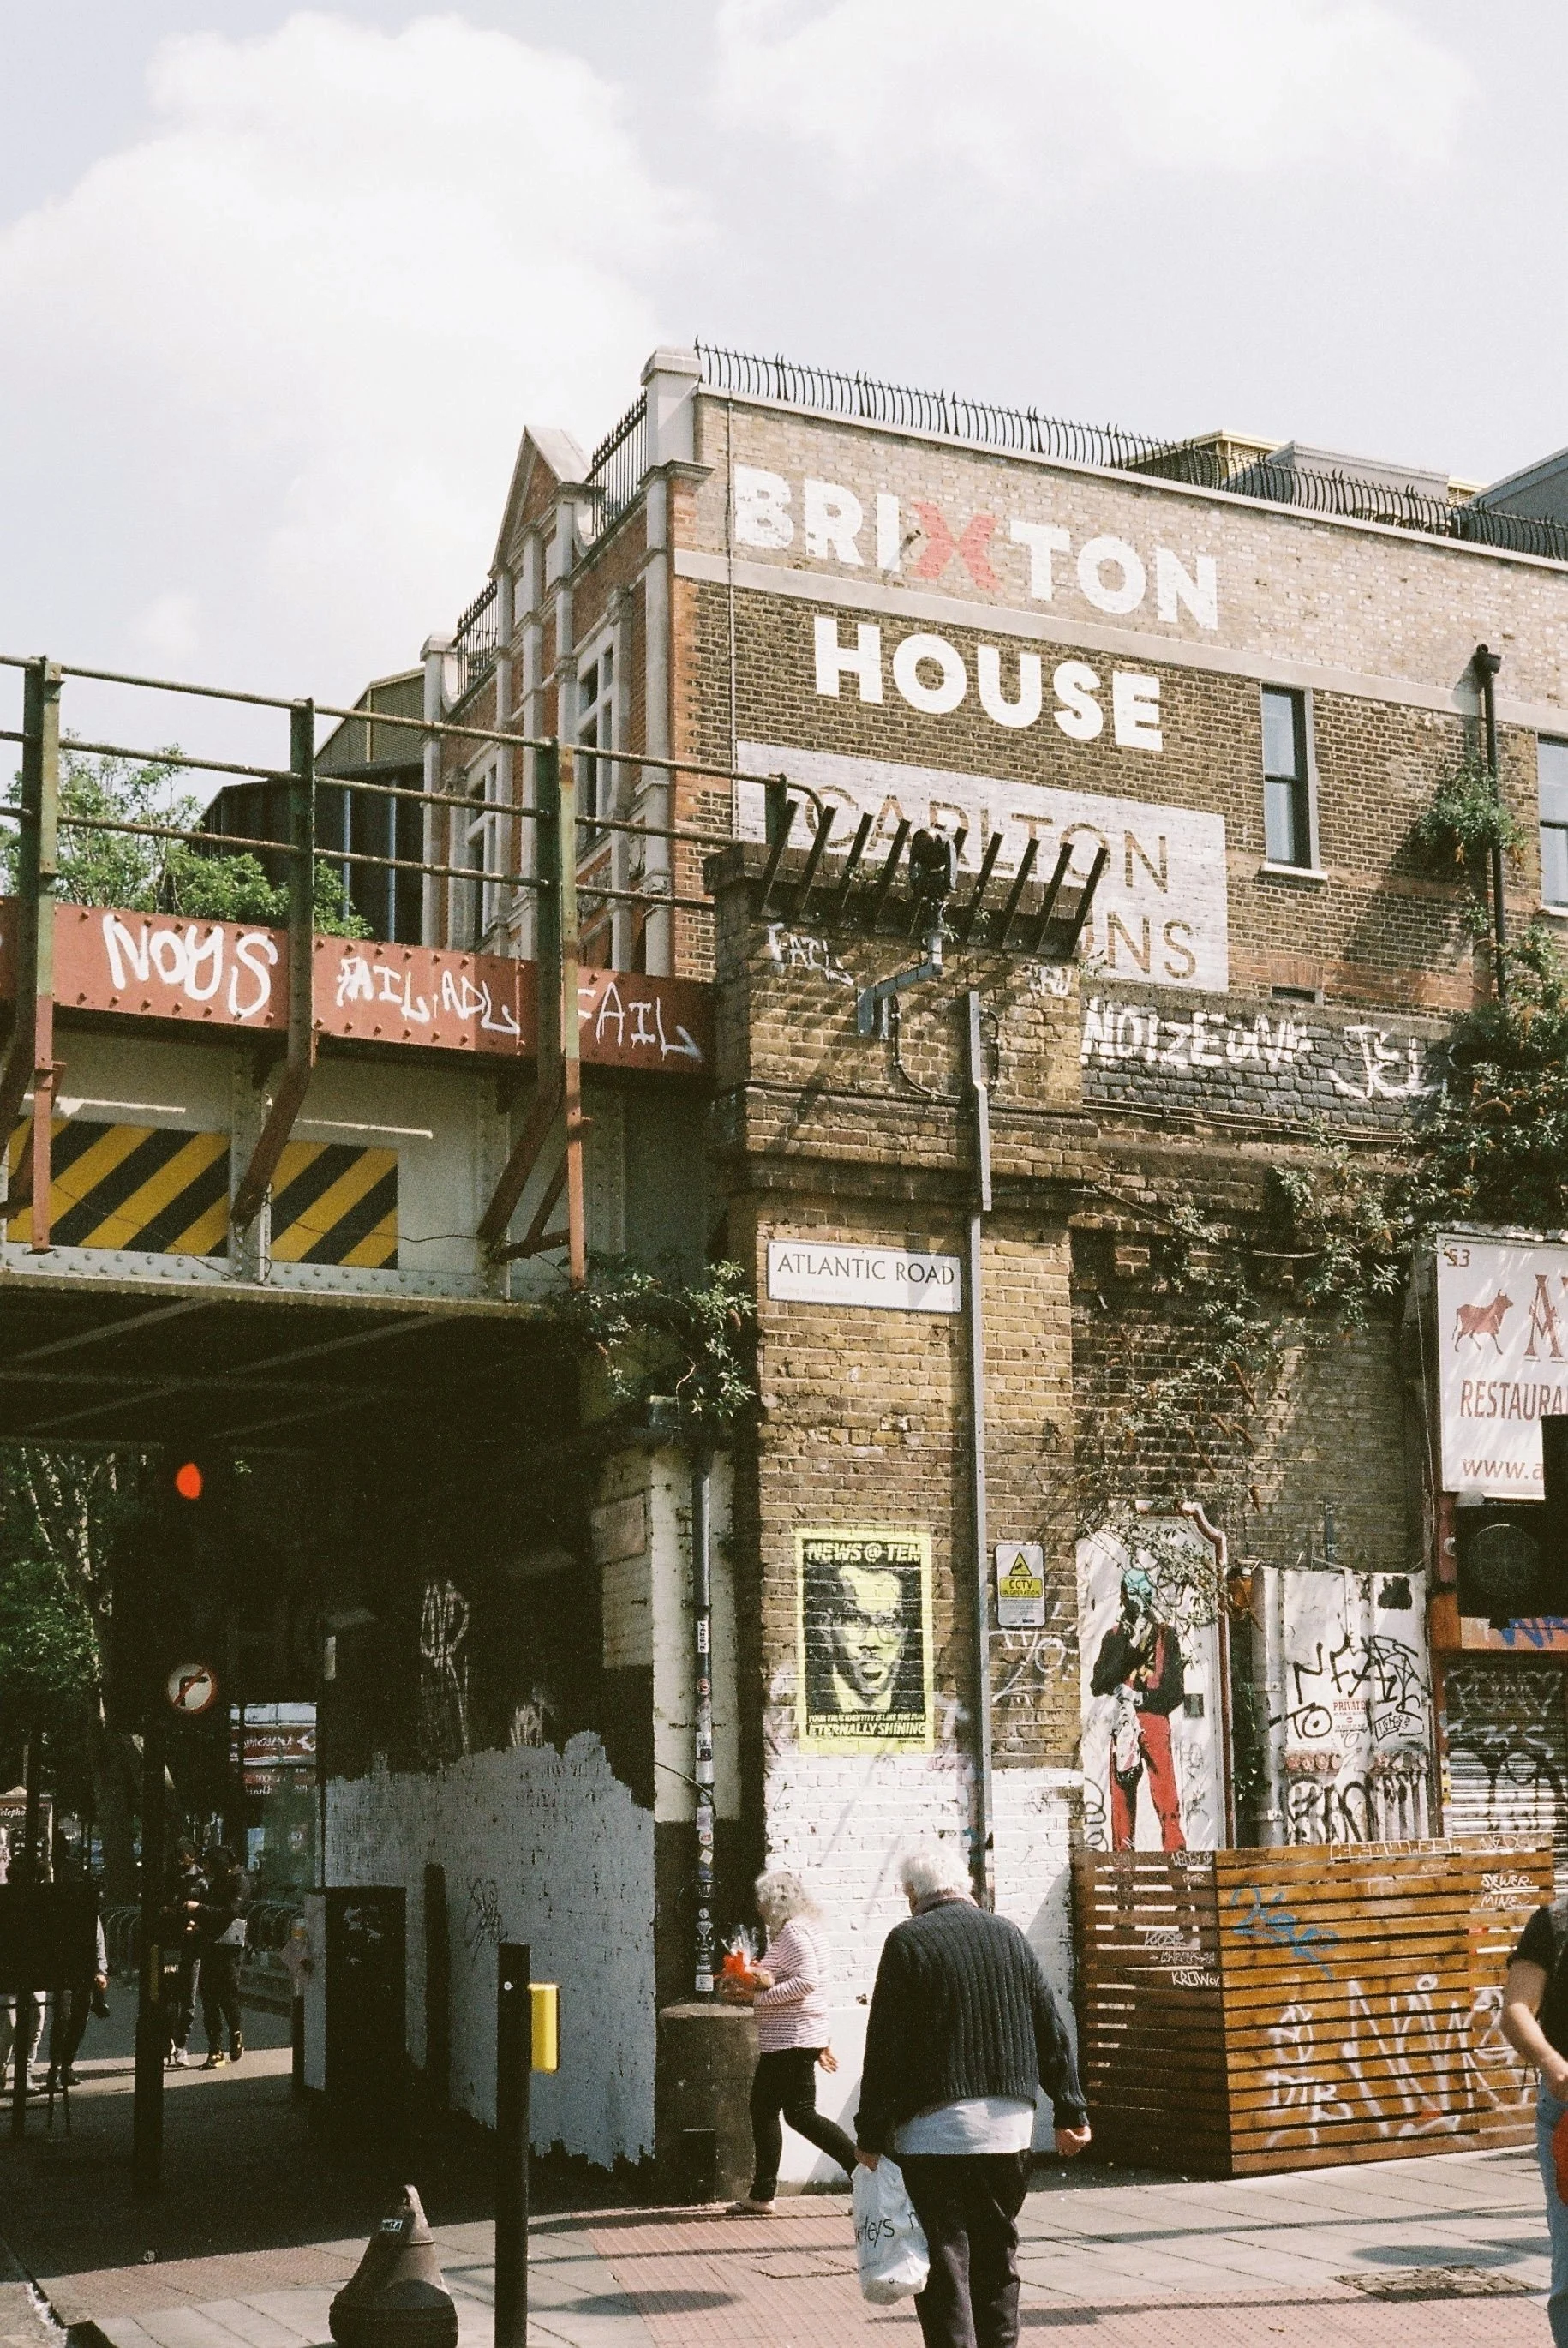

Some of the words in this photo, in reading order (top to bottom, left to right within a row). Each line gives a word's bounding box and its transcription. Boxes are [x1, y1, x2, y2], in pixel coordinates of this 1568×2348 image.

[733, 464, 1219, 631] BRIXTON
[814, 616, 1164, 752] HOUSE
[804, 784, 1169, 894] CARLTON
[777, 1253, 886, 1279] ATLANTIC
[896, 1262, 955, 1285] ROAD
[1523, 1274, 1568, 1363] A
[1460, 1380, 1568, 1421] RESTAURA
[1463, 1459, 1544, 1481] www.a
[807, 1542, 862, 1561] NEWS
[865, 1542, 882, 1563] @
[887, 1543, 921, 1562] TEN
[1008, 1579, 1033, 1590] CCTV
[808, 1713, 826, 1722] YOUR
[845, 1713, 875, 1722] IDENTITY
[1333, 1700, 1366, 1711] PRIVATE
[809, 1723, 877, 1736] ETERNALLY
[877, 1722, 925, 1735] SHINING
